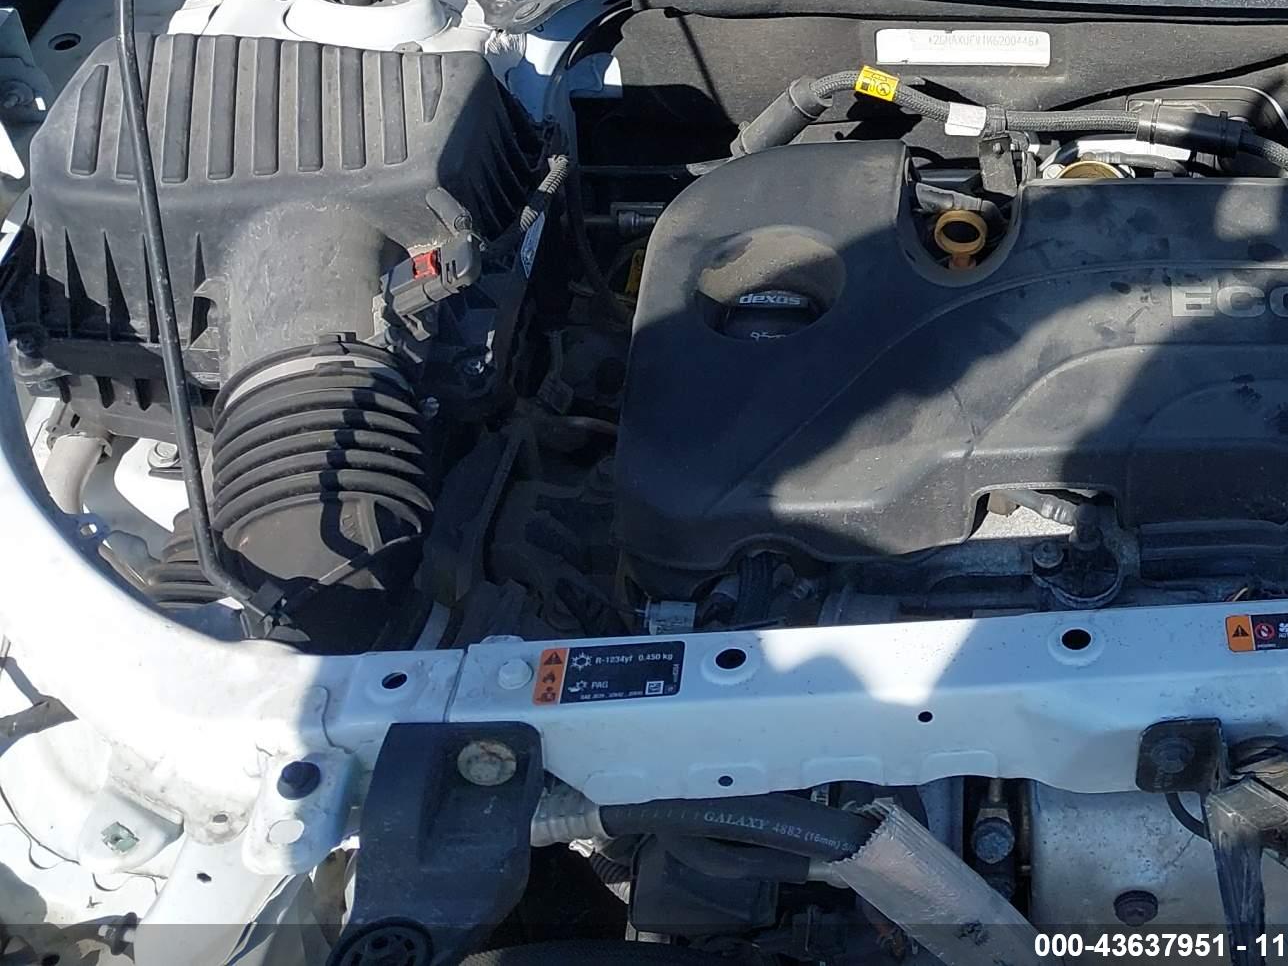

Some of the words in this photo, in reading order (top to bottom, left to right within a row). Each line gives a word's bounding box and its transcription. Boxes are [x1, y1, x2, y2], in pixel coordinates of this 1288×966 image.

[739, 293, 801, 305] dexos
[595, 655, 633, 666] R-1234yf
[638, 652, 661, 662] 0.450
[663, 652, 674, 662] kg
[591, 680, 609, 689] PAG
[703, 811, 767, 830] GALAXY
[804, 831, 841, 851] (16mm)
